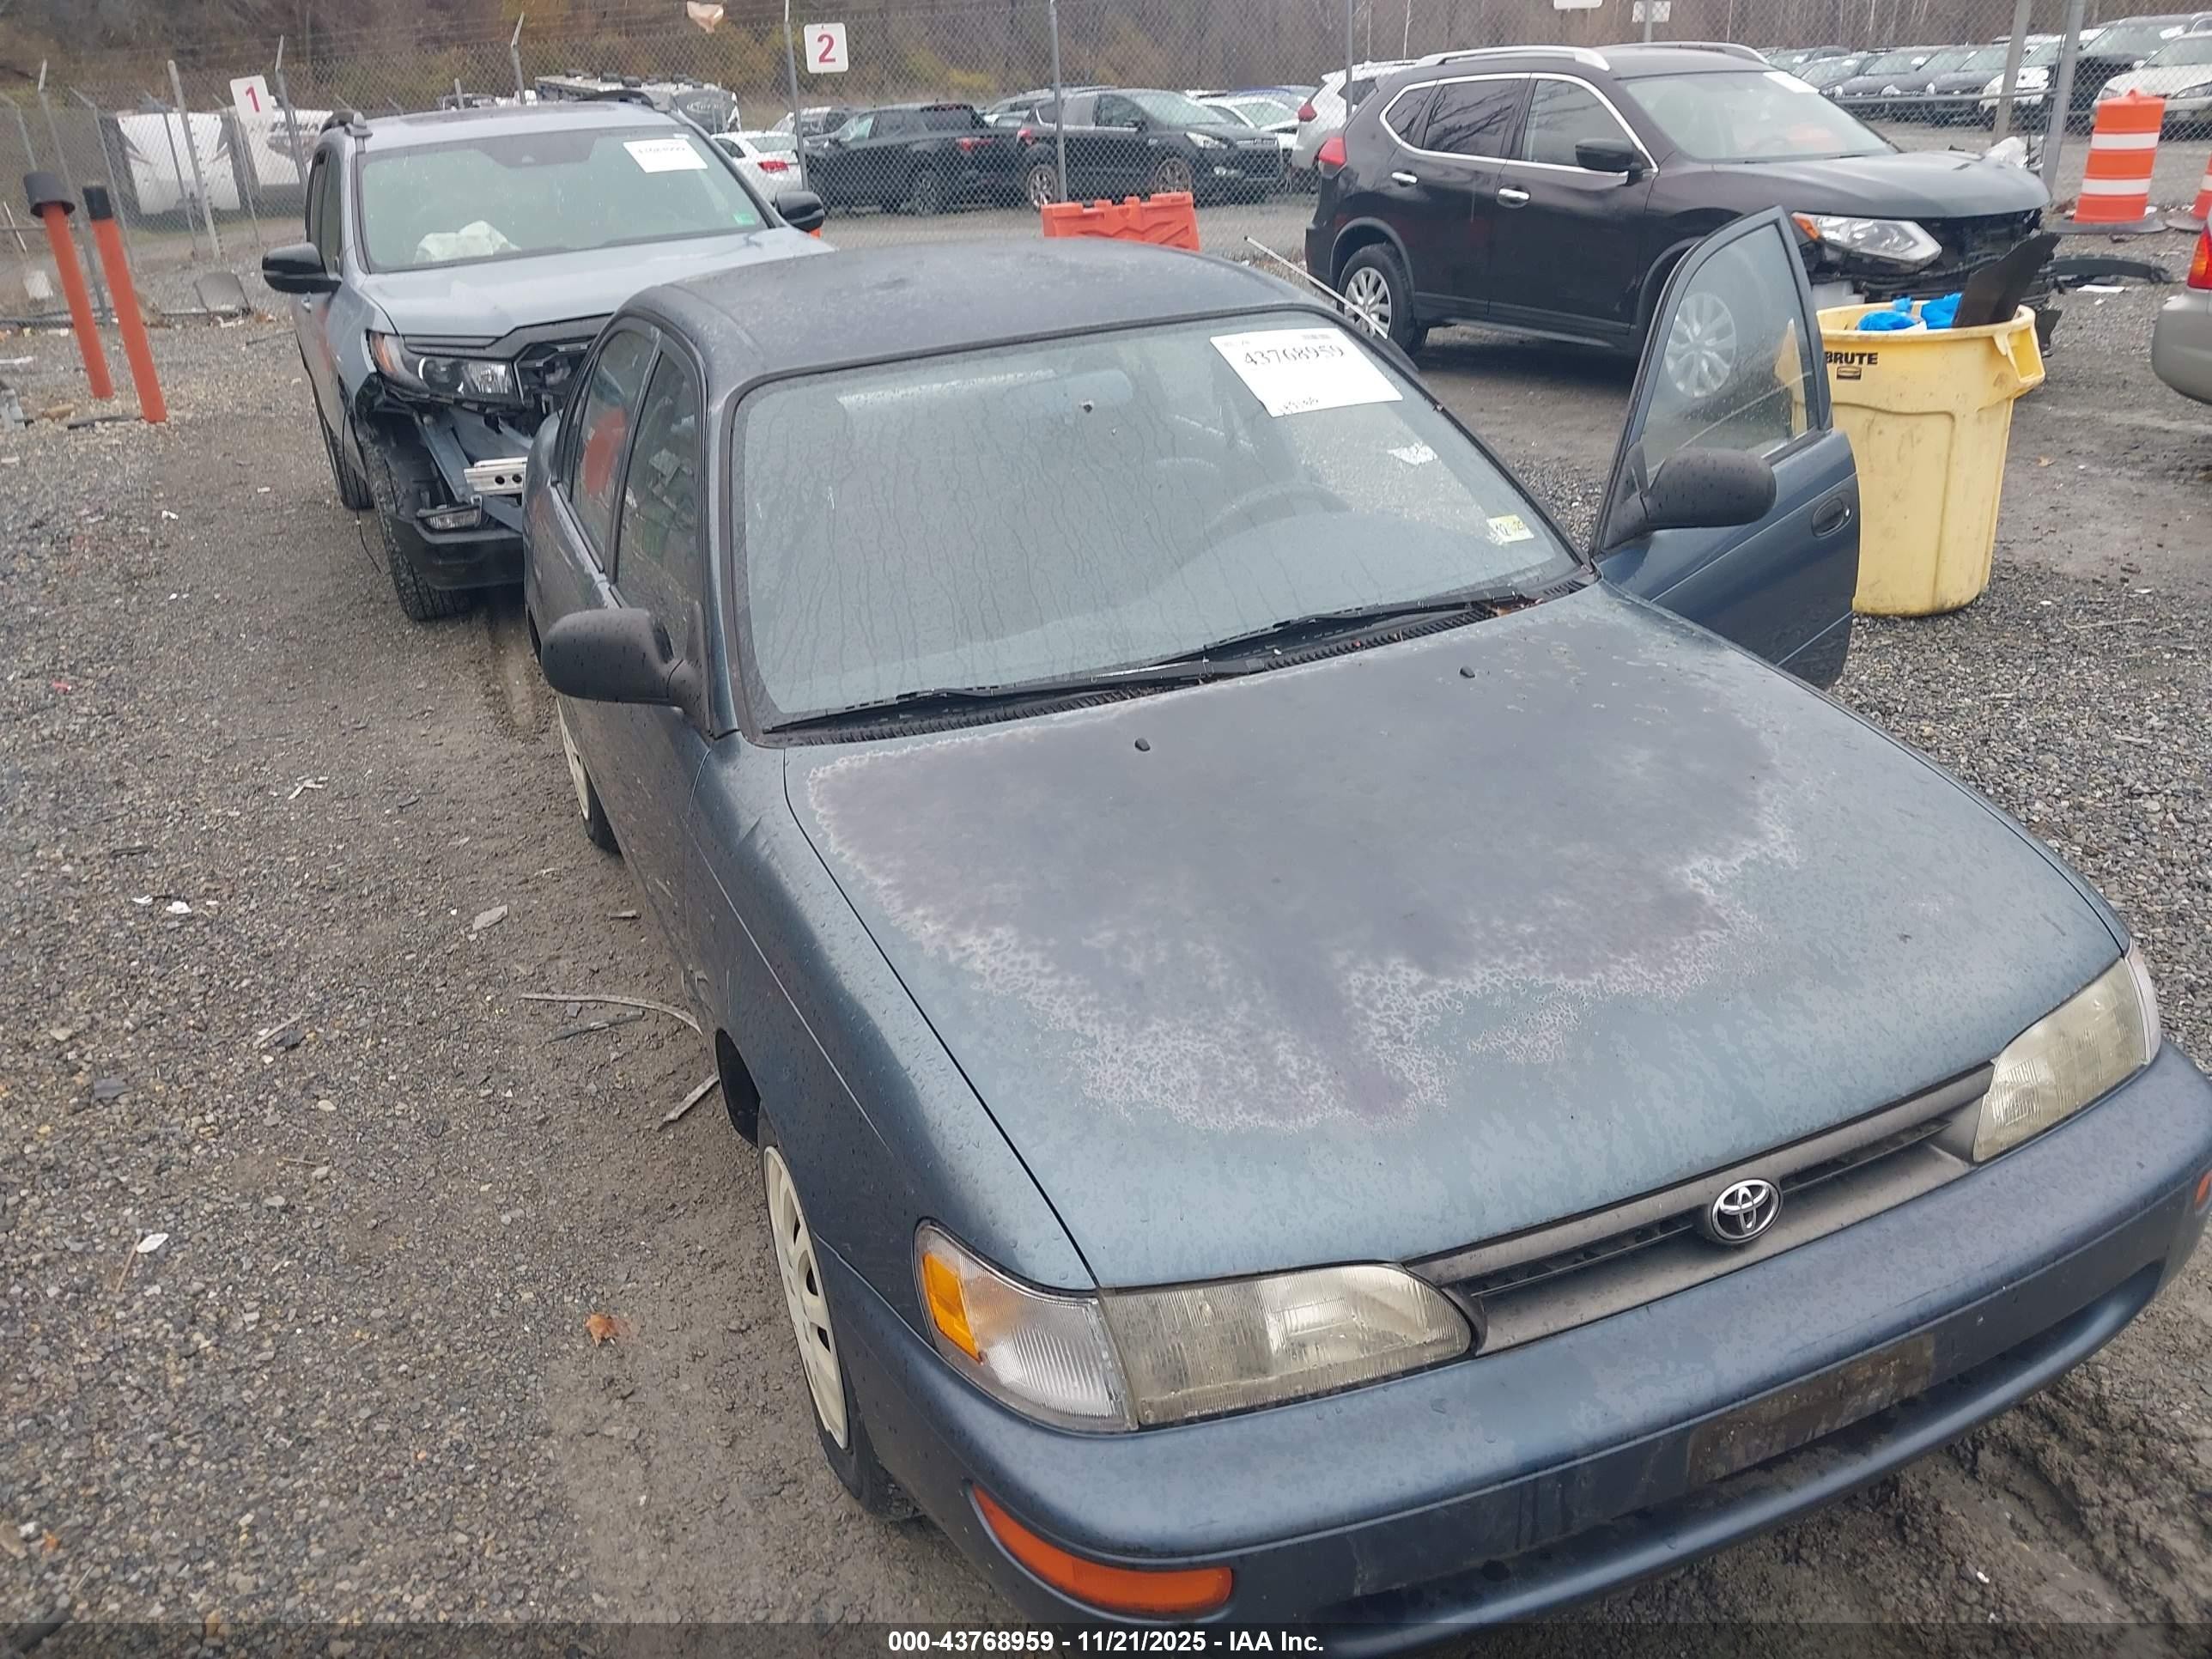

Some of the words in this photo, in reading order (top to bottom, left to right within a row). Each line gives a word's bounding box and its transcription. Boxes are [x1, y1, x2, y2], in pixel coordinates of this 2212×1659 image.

[817, 34, 836, 63] 2
[246, 87, 260, 112] 1
[1825, 351, 1879, 365] BRUTE
